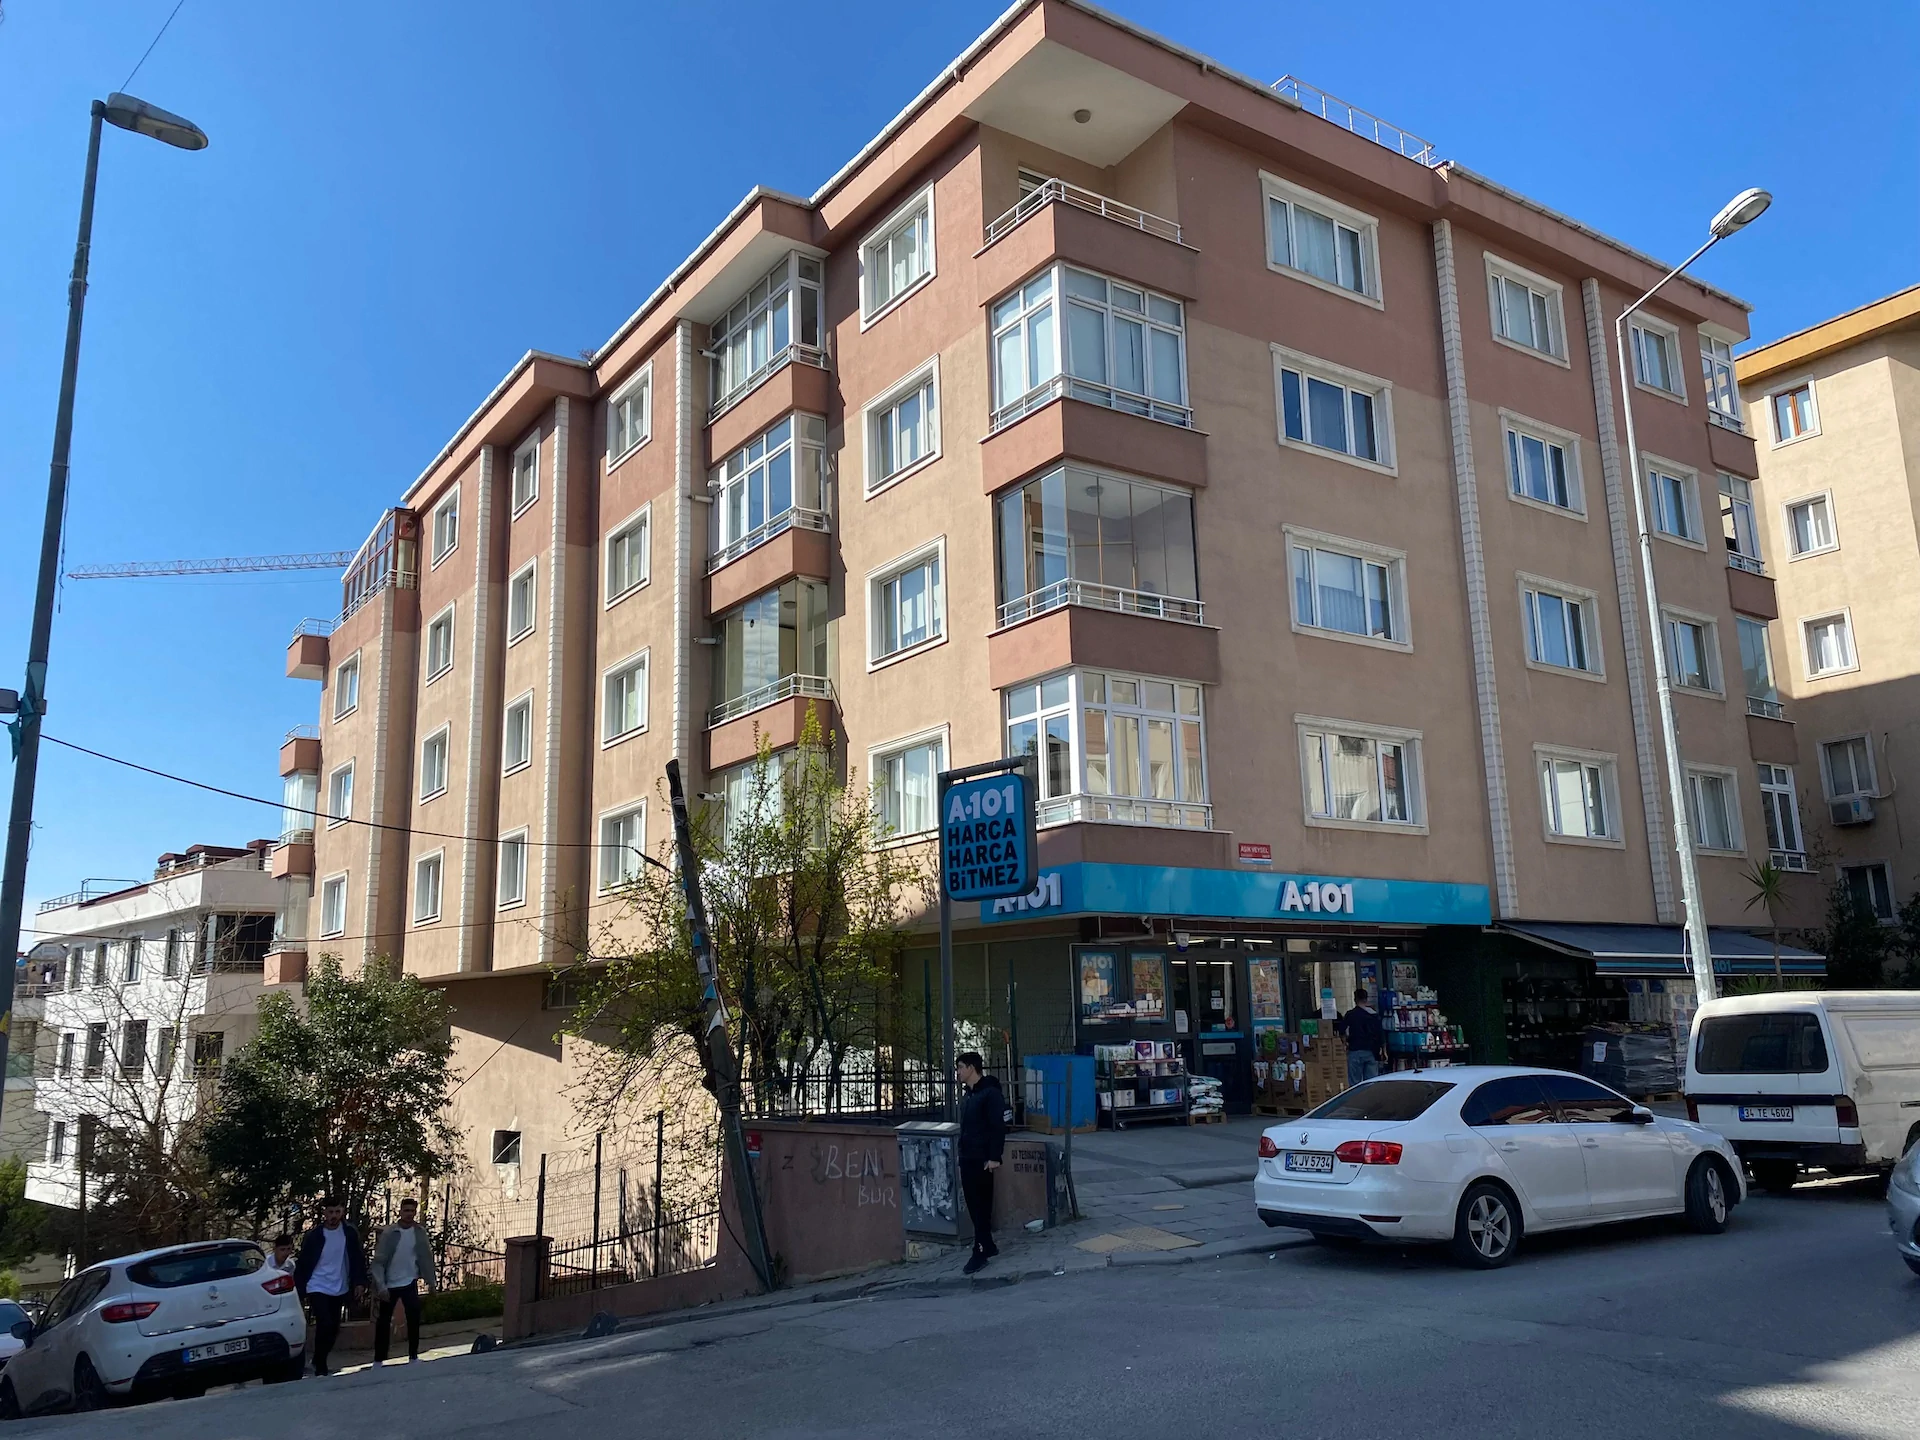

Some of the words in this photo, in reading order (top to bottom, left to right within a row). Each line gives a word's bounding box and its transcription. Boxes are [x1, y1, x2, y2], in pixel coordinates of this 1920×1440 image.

[948, 818, 1017, 847] HARCA
[948, 840, 1018, 869] HARCA
[1744, 1108, 1754, 1118] 34
[1757, 1108, 1768, 1118] TE
[1770, 1108, 1791, 1118] 4602
[824, 1145, 879, 1179] BEN
[1289, 1155, 1298, 1166] 34
[1310, 1156, 1330, 1168] 5734
[189, 1350, 201, 1360] 34
[206, 1346, 219, 1357] RL
[224, 1340, 247, 1353] 0893
